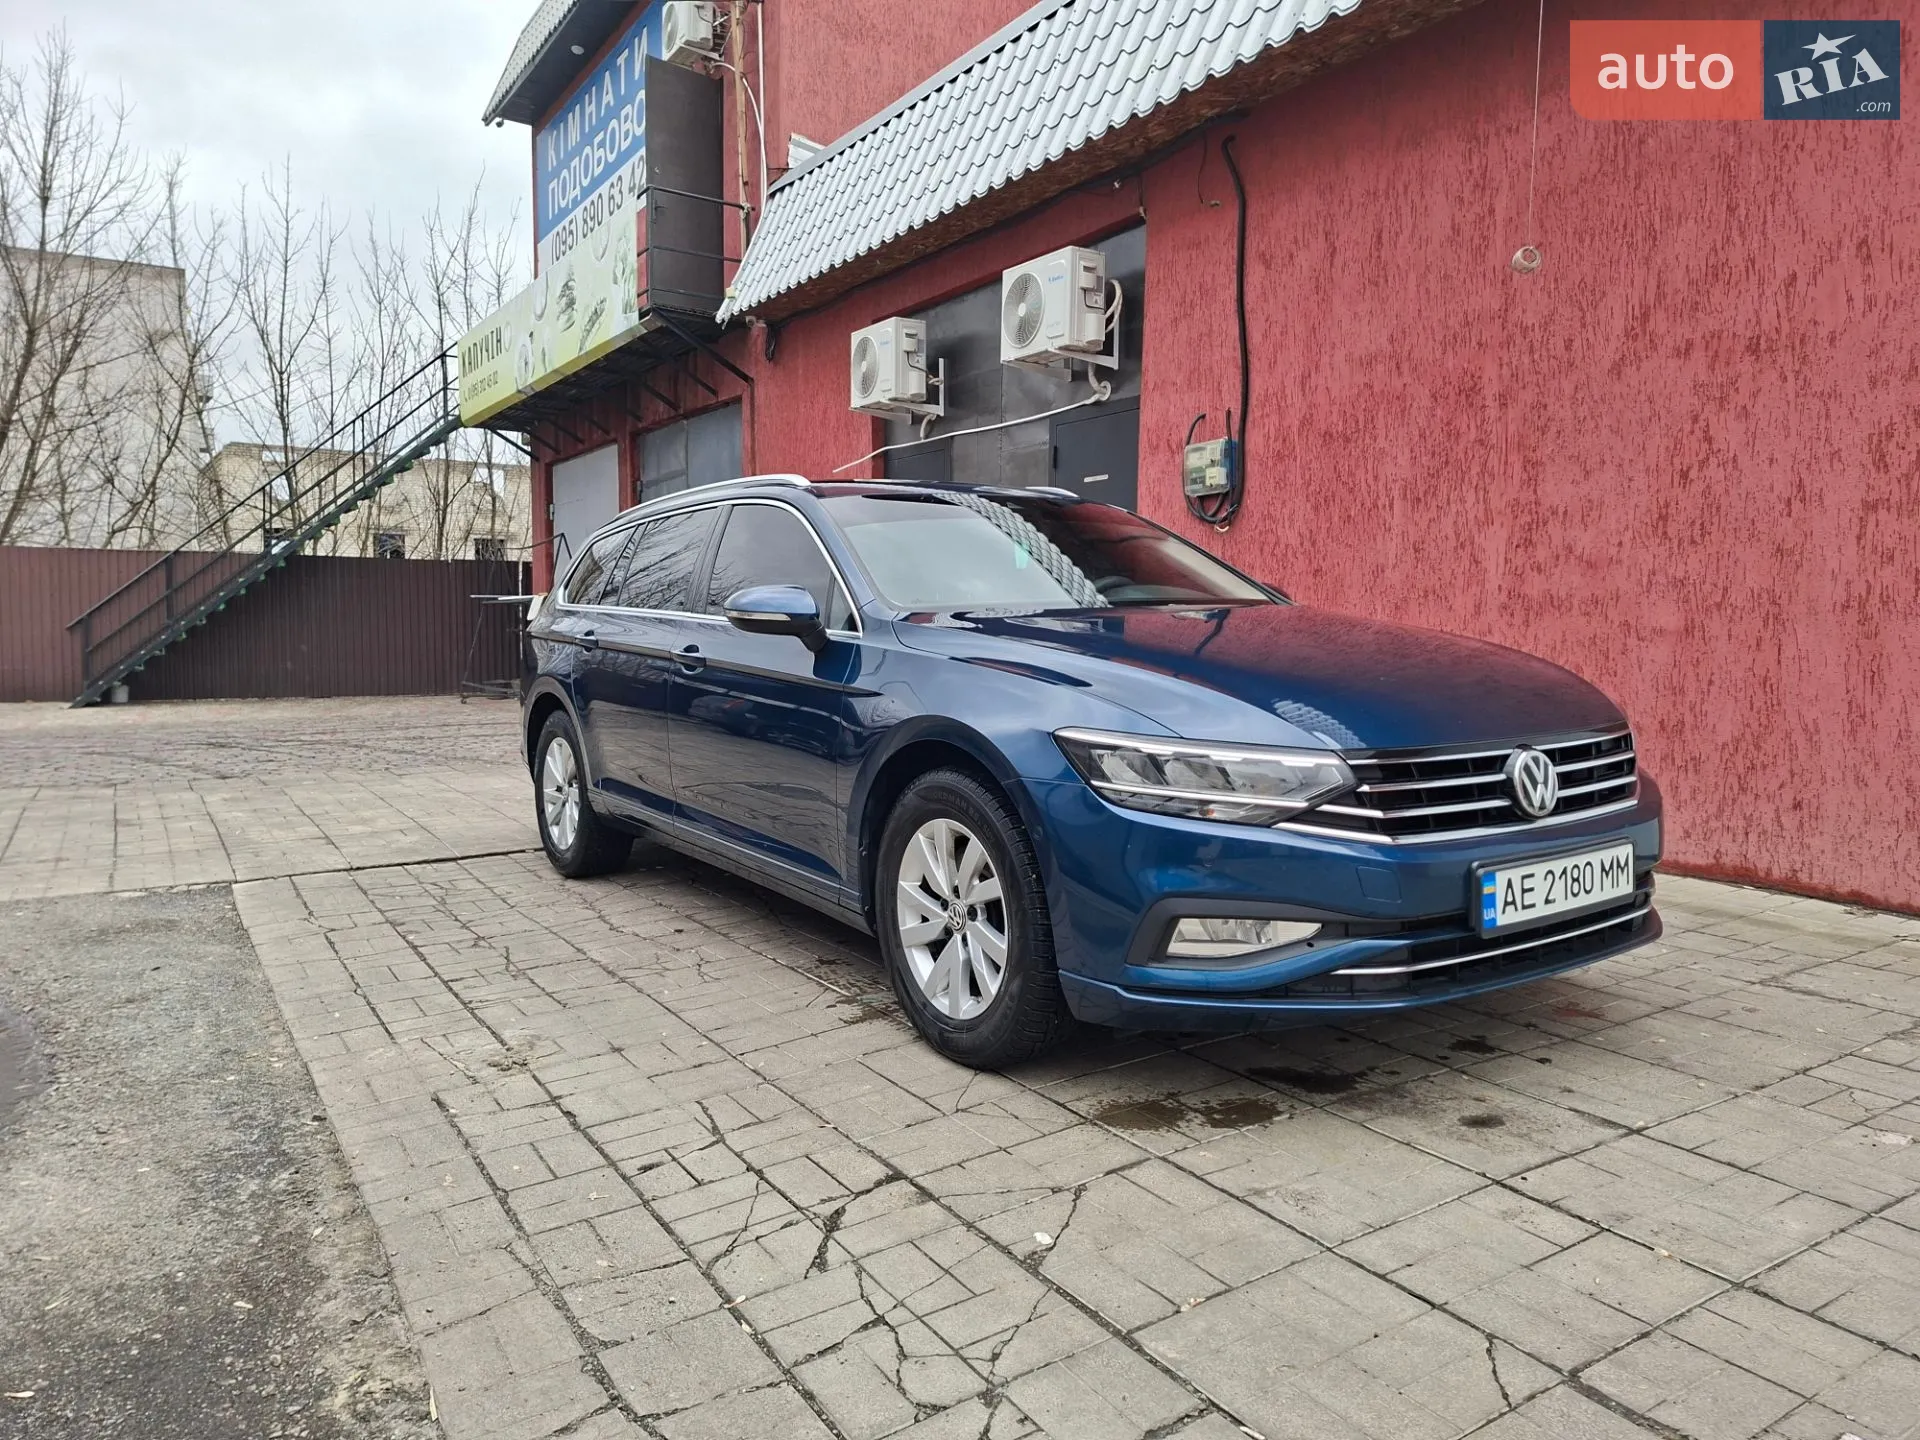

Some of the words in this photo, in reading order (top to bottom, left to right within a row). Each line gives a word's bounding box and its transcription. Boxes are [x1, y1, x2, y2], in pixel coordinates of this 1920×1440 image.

[548, 26, 648, 172] КІМНАТИ
[548, 88, 646, 221] ПОДОБОВО
[551, 214, 578, 266] (095)
[582, 194, 604, 240] 890
[608, 174, 624, 217] 63
[628, 154, 646, 199] 42
[1483, 908, 1496, 920] UA
[1501, 873, 1536, 916] AE
[1543, 861, 1595, 905] 2180
[1600, 852, 1630, 892] MM
